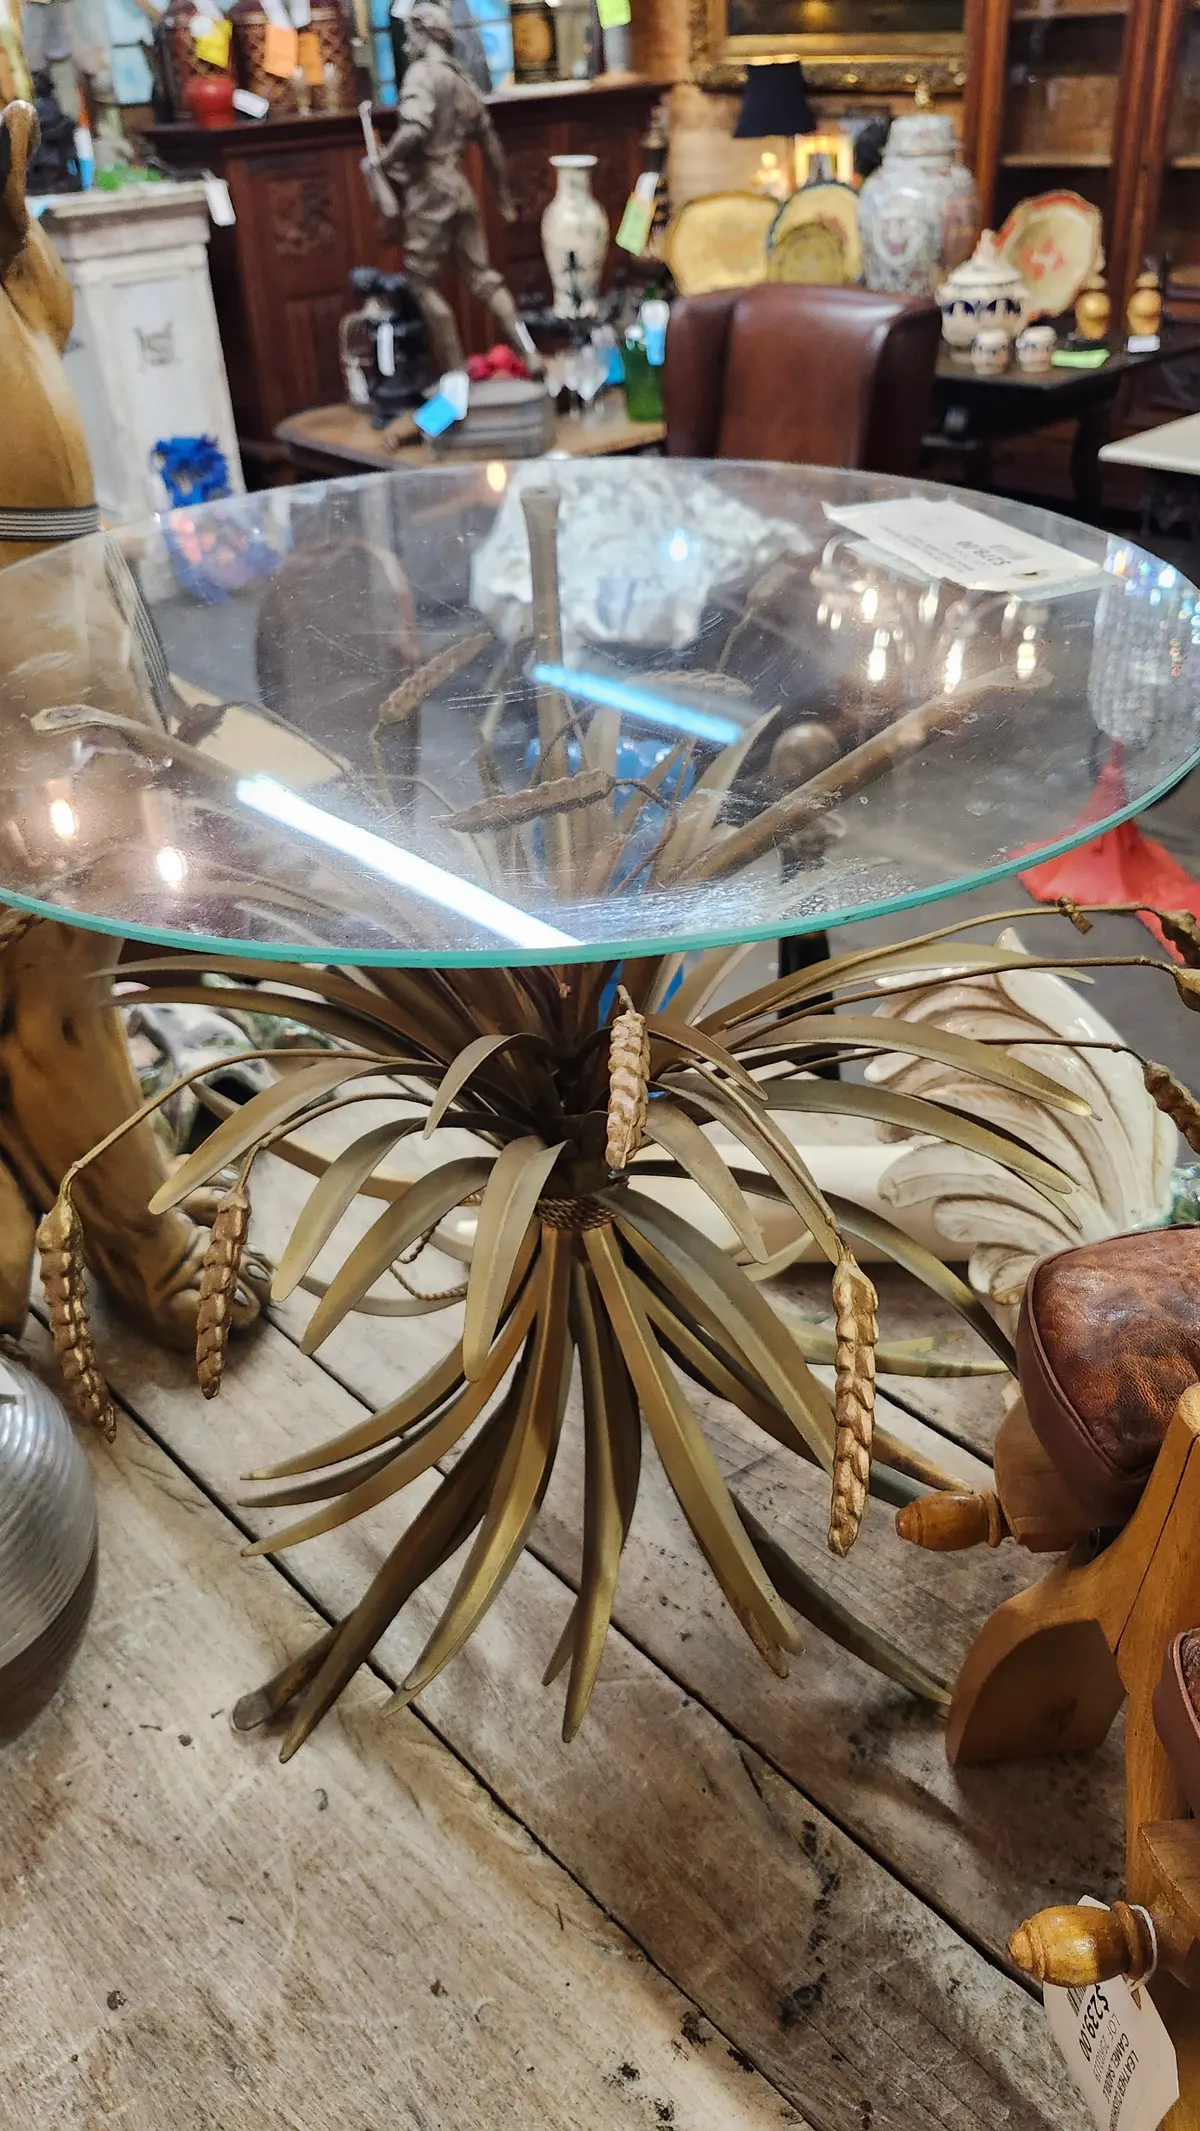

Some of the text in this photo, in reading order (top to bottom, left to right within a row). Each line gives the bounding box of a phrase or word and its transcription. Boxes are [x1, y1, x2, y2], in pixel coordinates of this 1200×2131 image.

[1079, 1984, 1109, 2062] $239.00
[1106, 2012, 1120, 2041] LOF
[1103, 2032, 1129, 2104] CAMEL SADDLE
[1116, 2049, 1139, 2097] LEATHER
